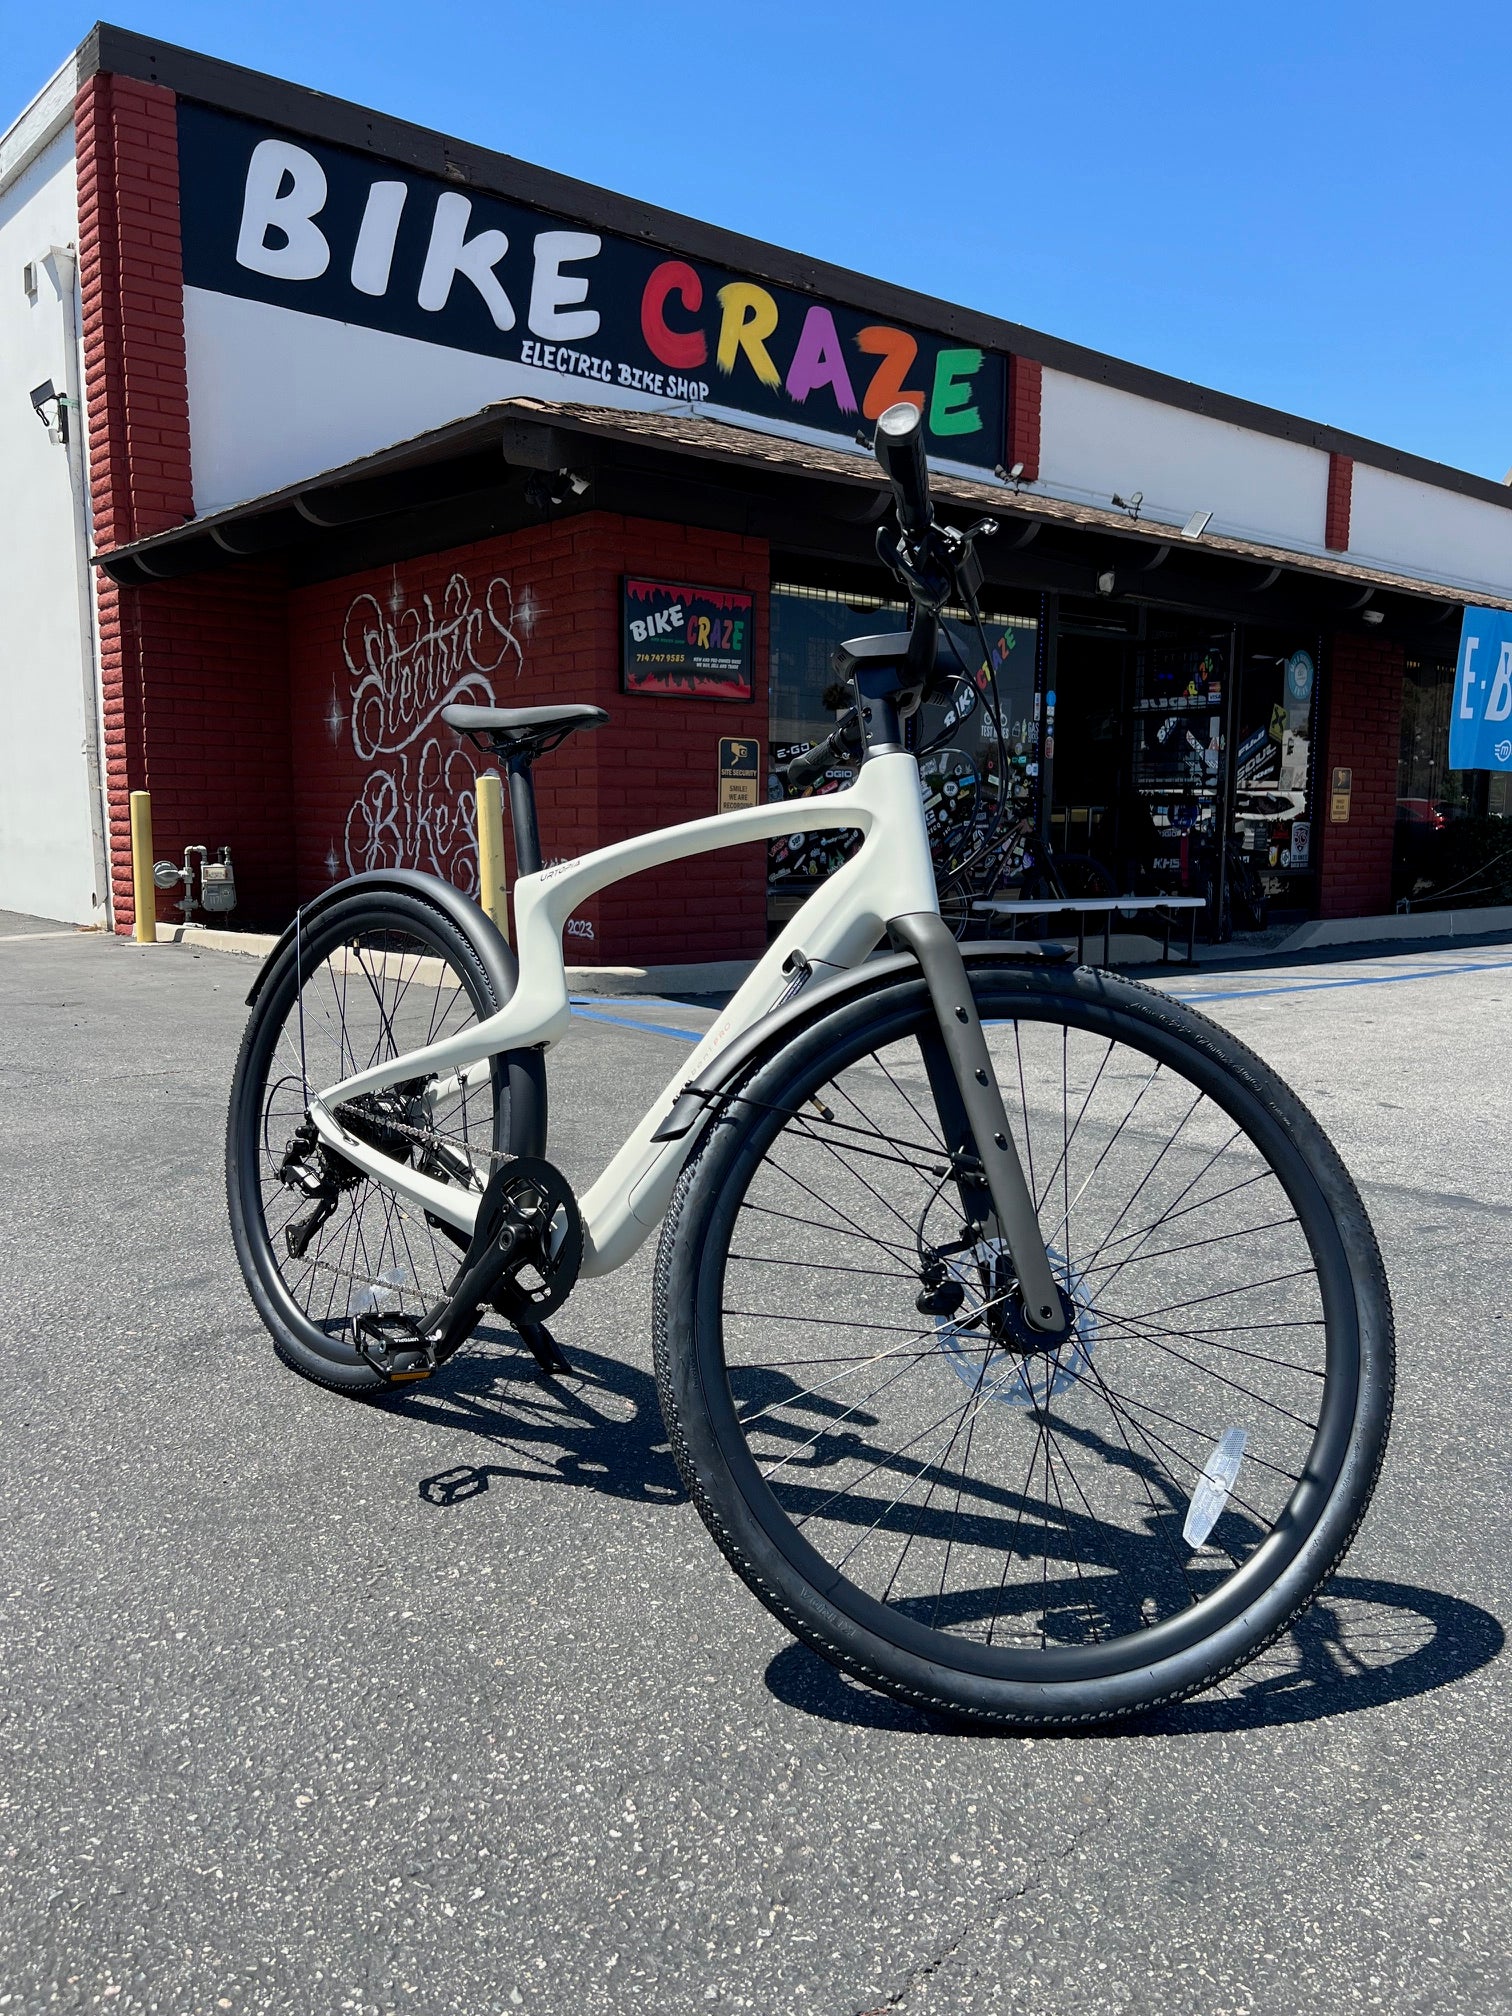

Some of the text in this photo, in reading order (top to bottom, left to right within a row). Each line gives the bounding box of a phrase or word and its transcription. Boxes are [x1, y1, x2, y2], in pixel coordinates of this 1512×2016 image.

[236, 139, 985, 437] BIKE CRAZE
[520, 340, 711, 402] ELECTRIC BIKE SHOP
[629, 604, 745, 650] BIKE CRAZE
[636, 653, 686, 663] 714 747 9585
[721, 768, 757, 778] SITE SECURITY
[728, 793, 738, 801] WE
[567, 918, 595, 940] 2023
